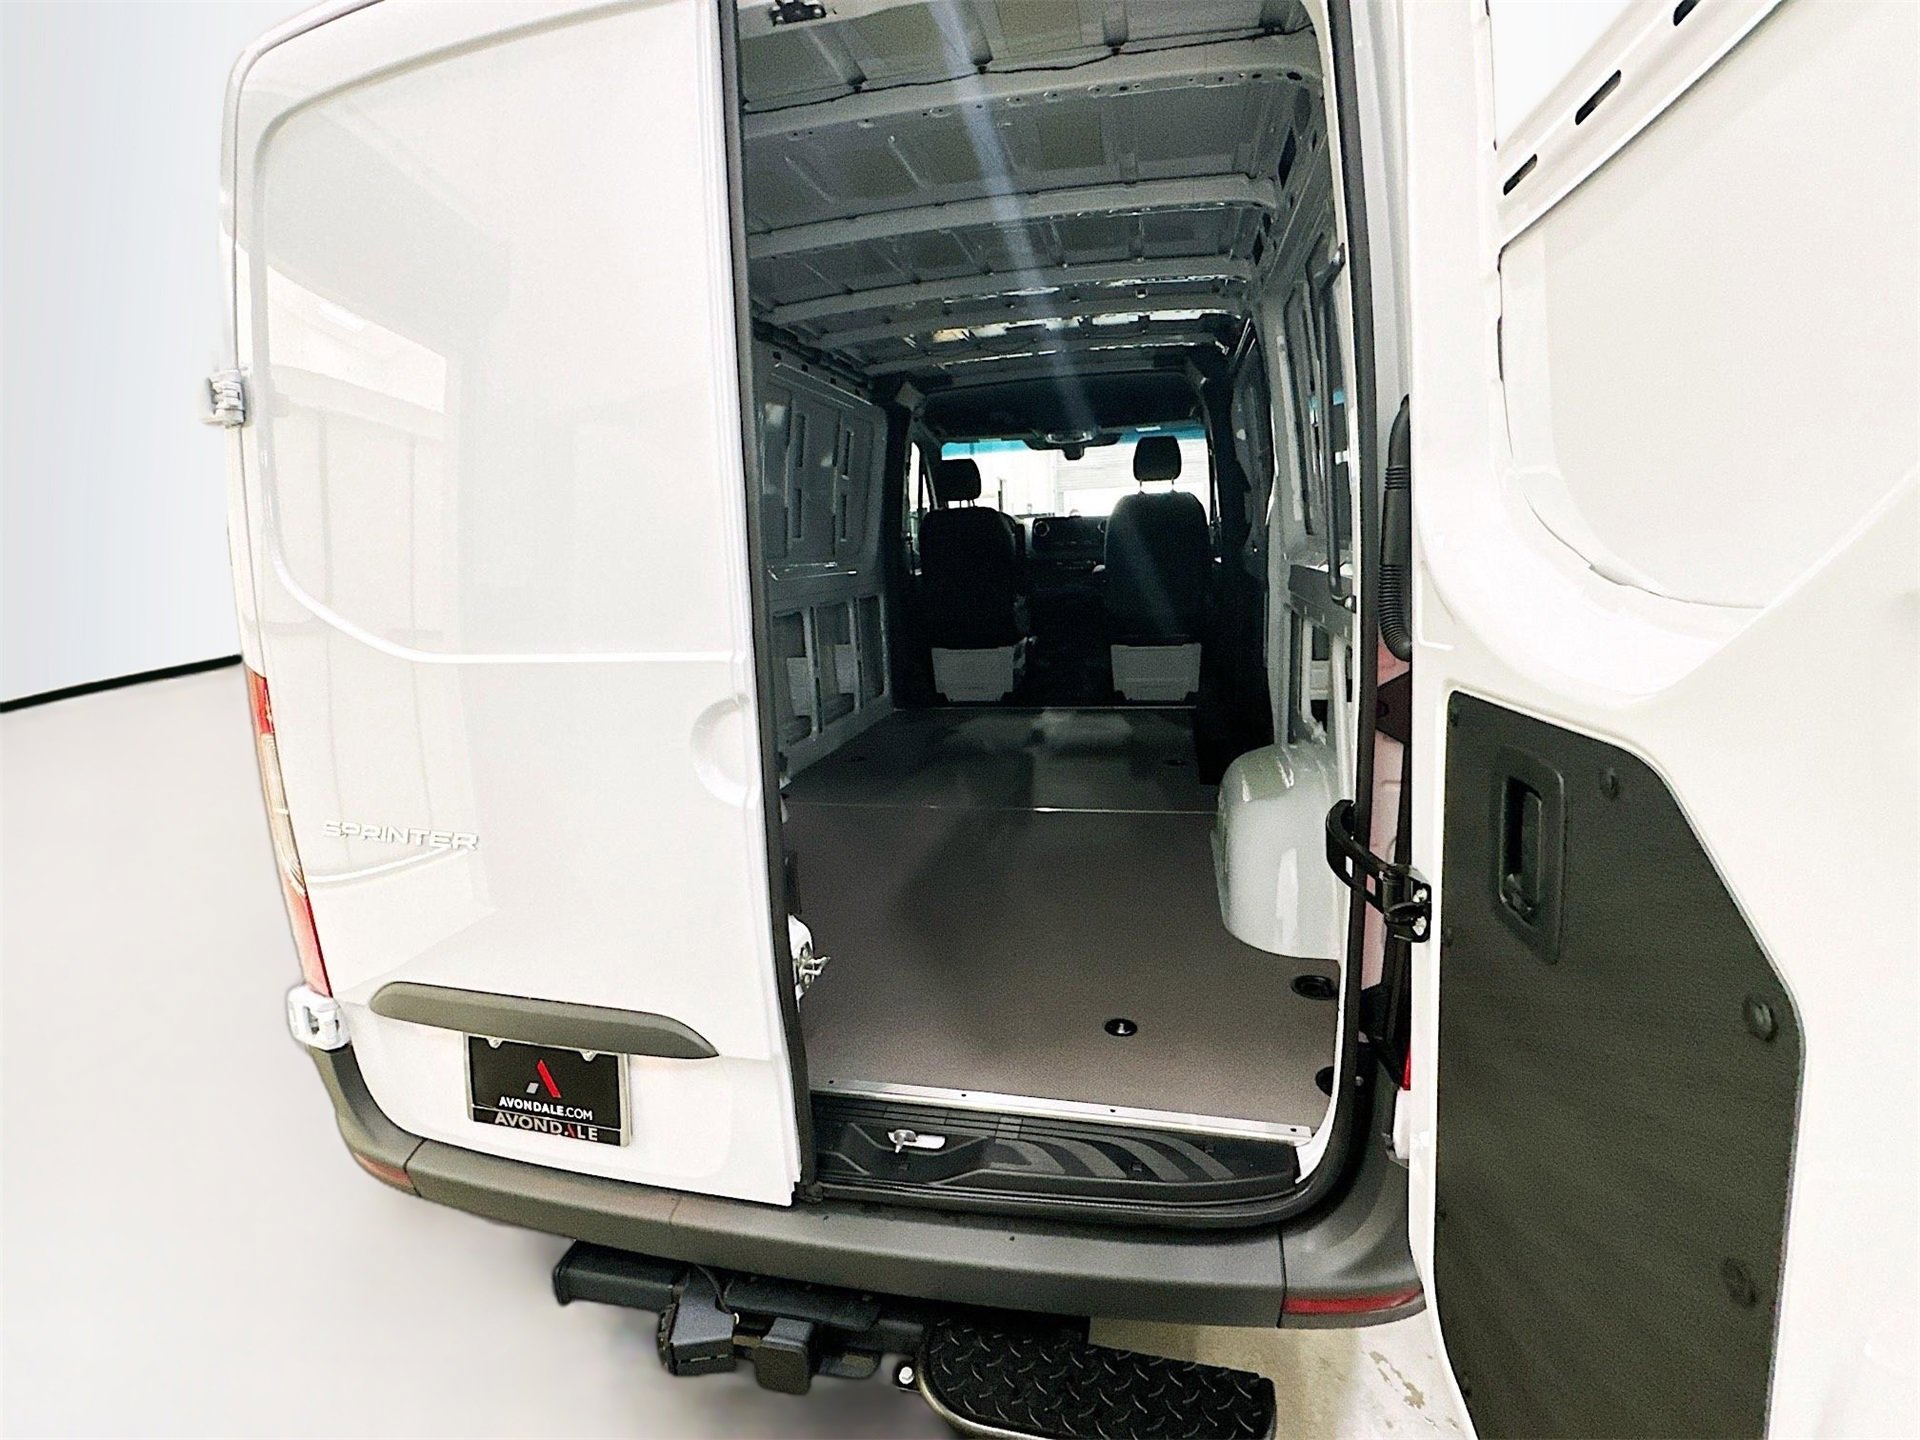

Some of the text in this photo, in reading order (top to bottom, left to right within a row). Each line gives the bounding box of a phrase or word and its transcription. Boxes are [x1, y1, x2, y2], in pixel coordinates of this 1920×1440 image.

[323, 821, 479, 850] SPRINTER
[499, 1096, 593, 1120] AVONDALE.COM
[494, 1112, 598, 1140] AVONDALE
